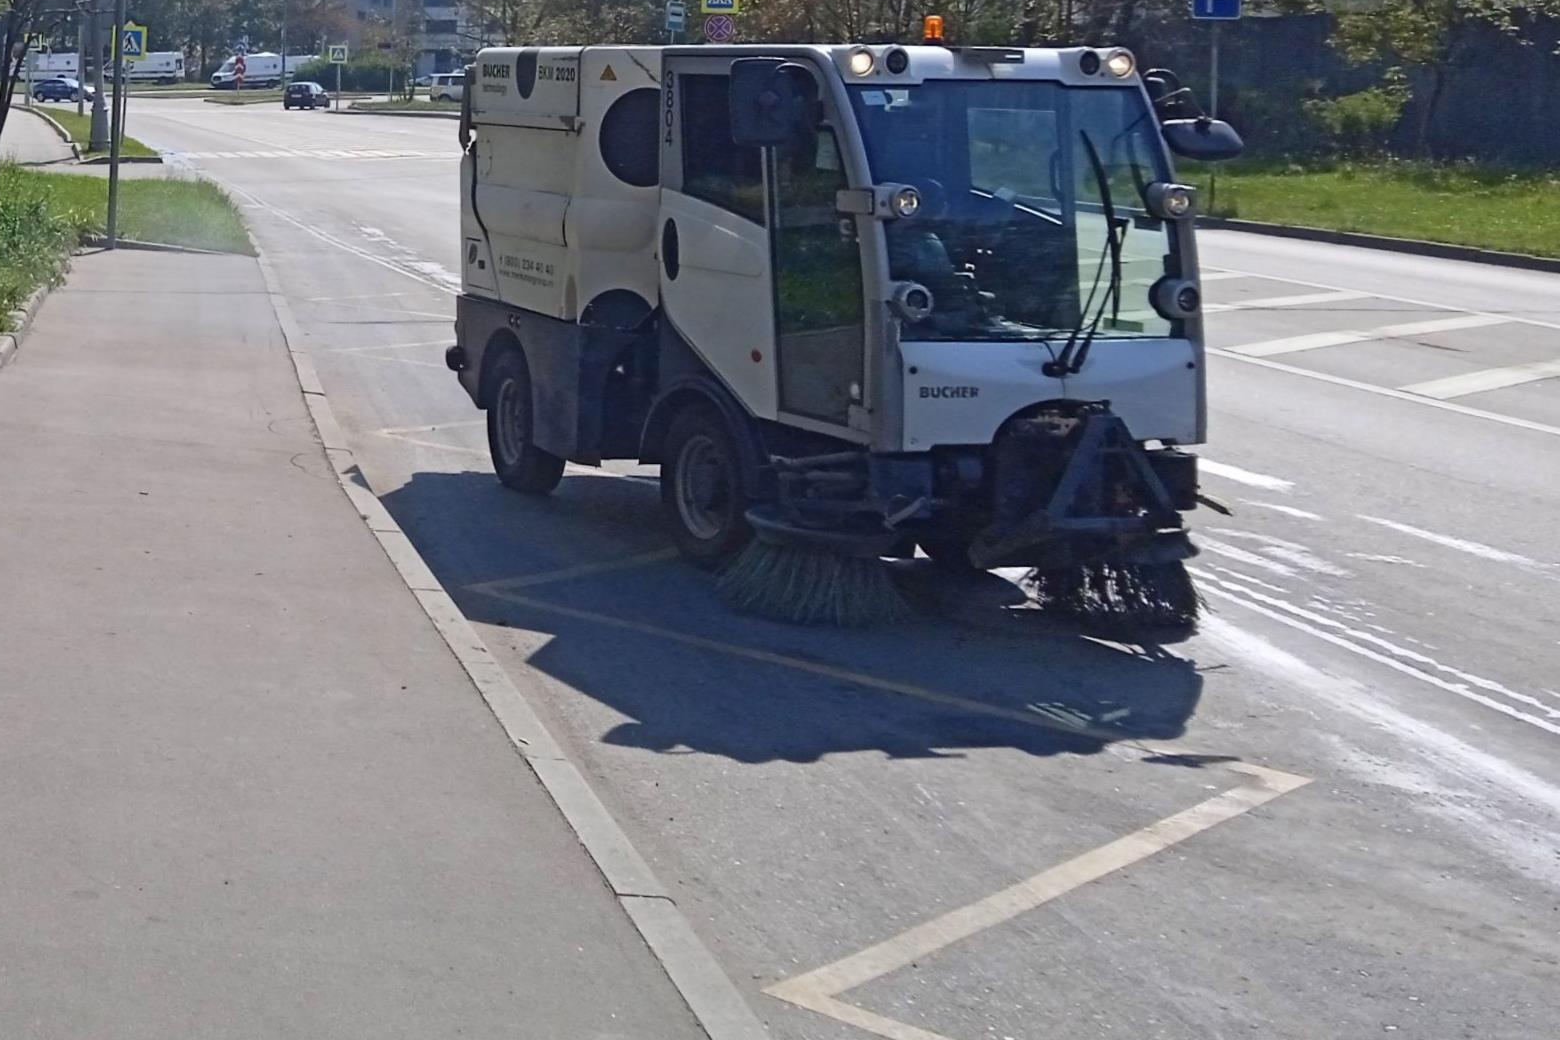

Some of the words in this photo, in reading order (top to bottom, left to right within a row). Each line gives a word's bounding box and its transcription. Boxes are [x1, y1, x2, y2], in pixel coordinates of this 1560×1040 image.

[483, 64, 510, 79] BUCHER
[556, 67, 576, 82] 2020
[919, 386, 979, 399] BUCHER
